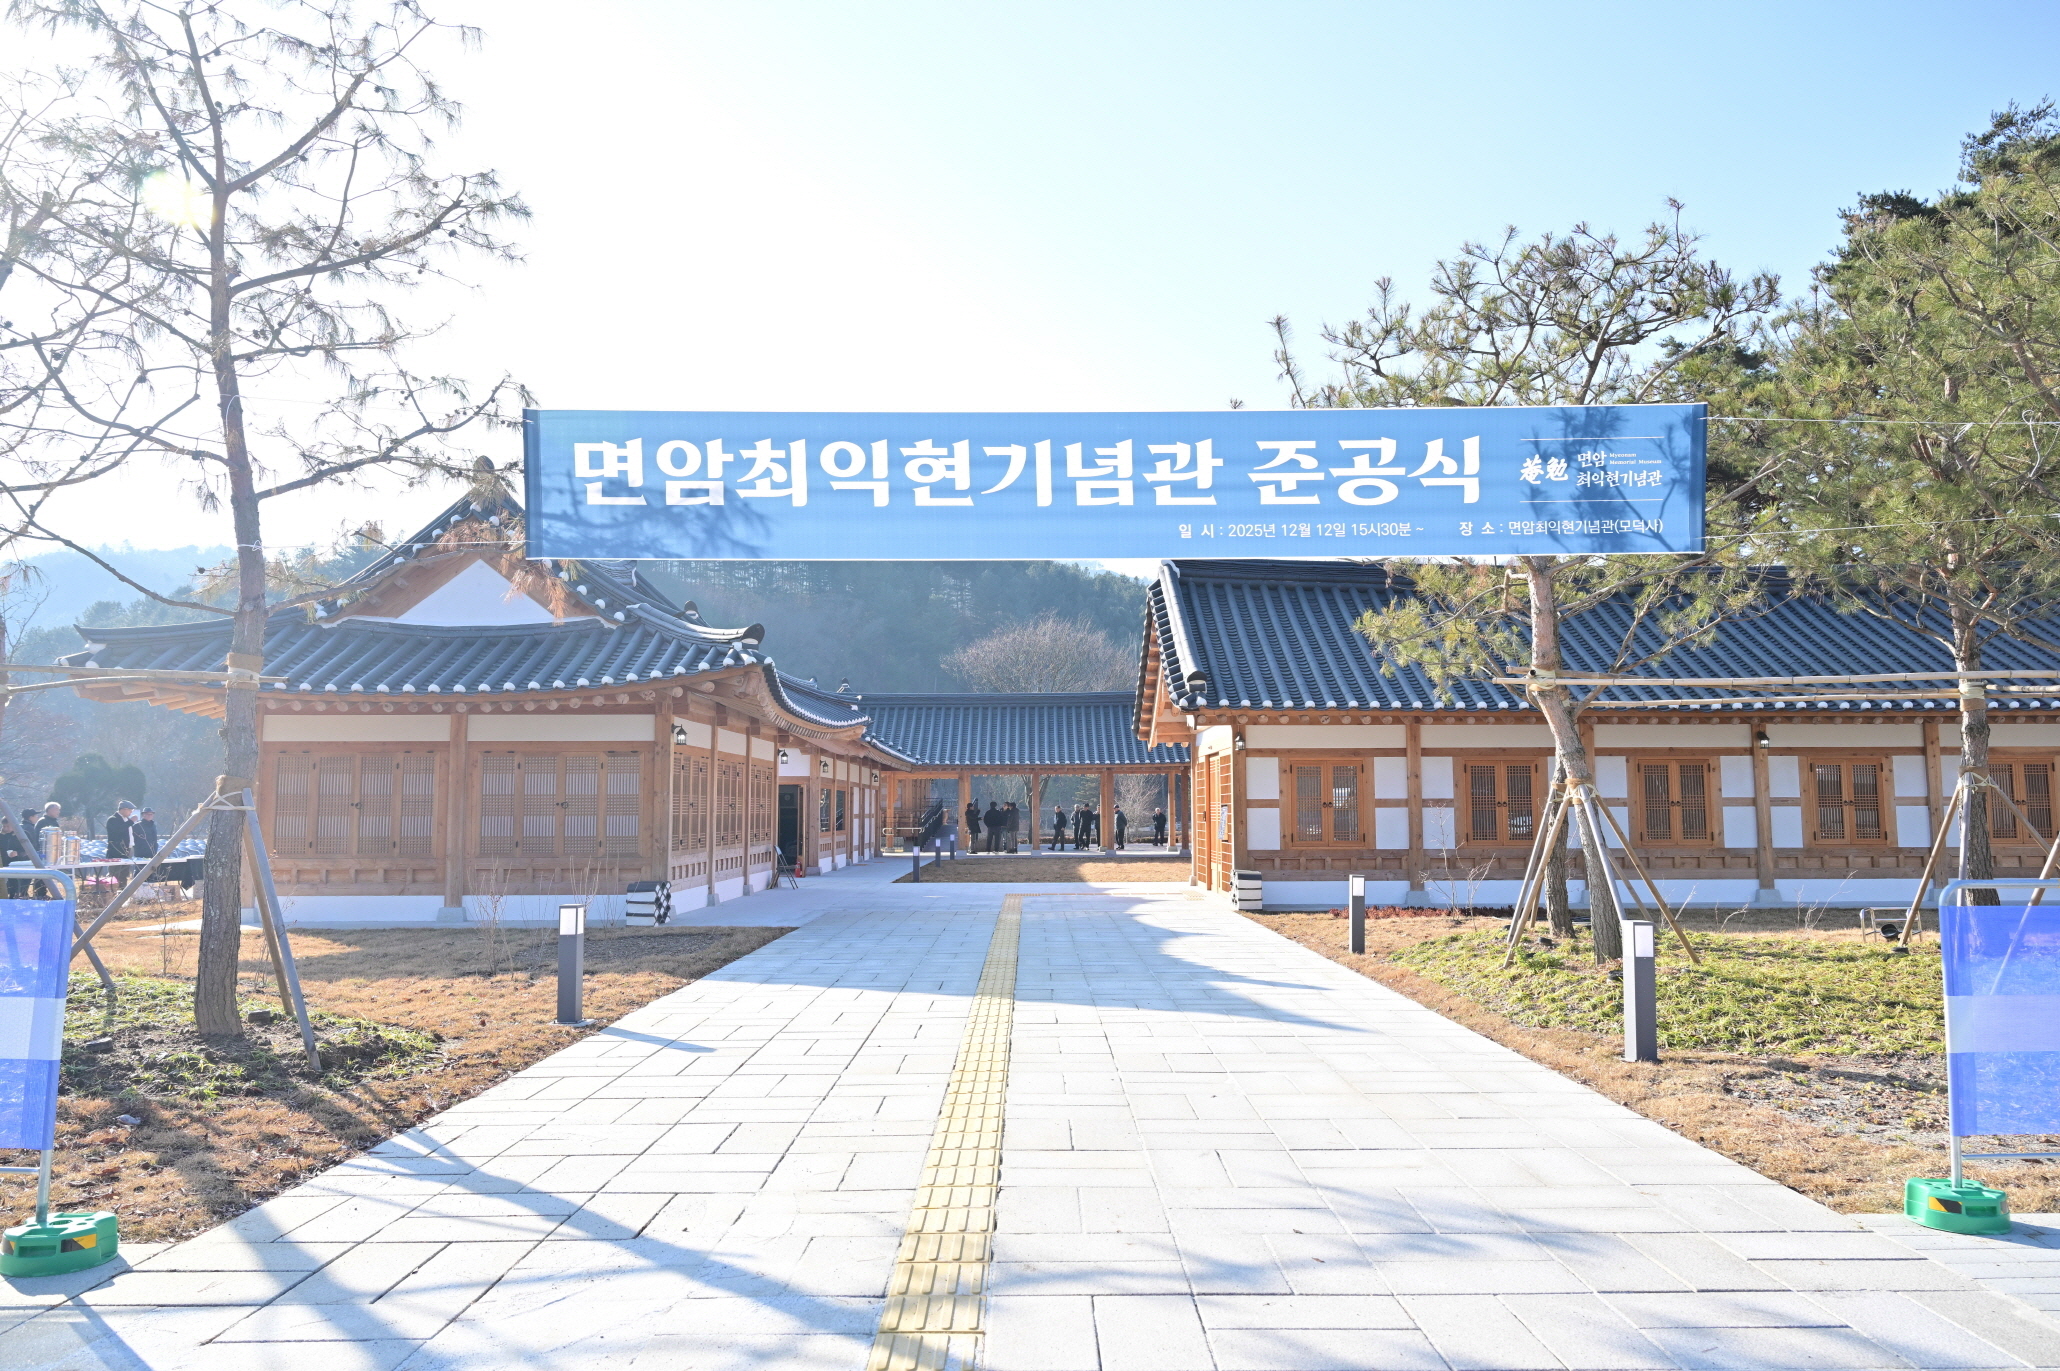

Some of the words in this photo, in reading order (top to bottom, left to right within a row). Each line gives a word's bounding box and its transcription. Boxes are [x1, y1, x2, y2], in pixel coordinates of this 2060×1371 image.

[1577, 450, 1608, 468] 면암
[573, 437, 1224, 507] 면암최익현기념관
[1247, 435, 1480, 505] 준공식
[1576, 470, 1663, 488] 최익현기념관
[1227, 523, 1276, 538] 2025년
[1281, 522, 1311, 538] 12월
[1316, 522, 1346, 538] 12일
[1351, 522, 1412, 537] 15시30분
[1508, 518, 1664, 536] 면암최익현기념관(모덕사)
